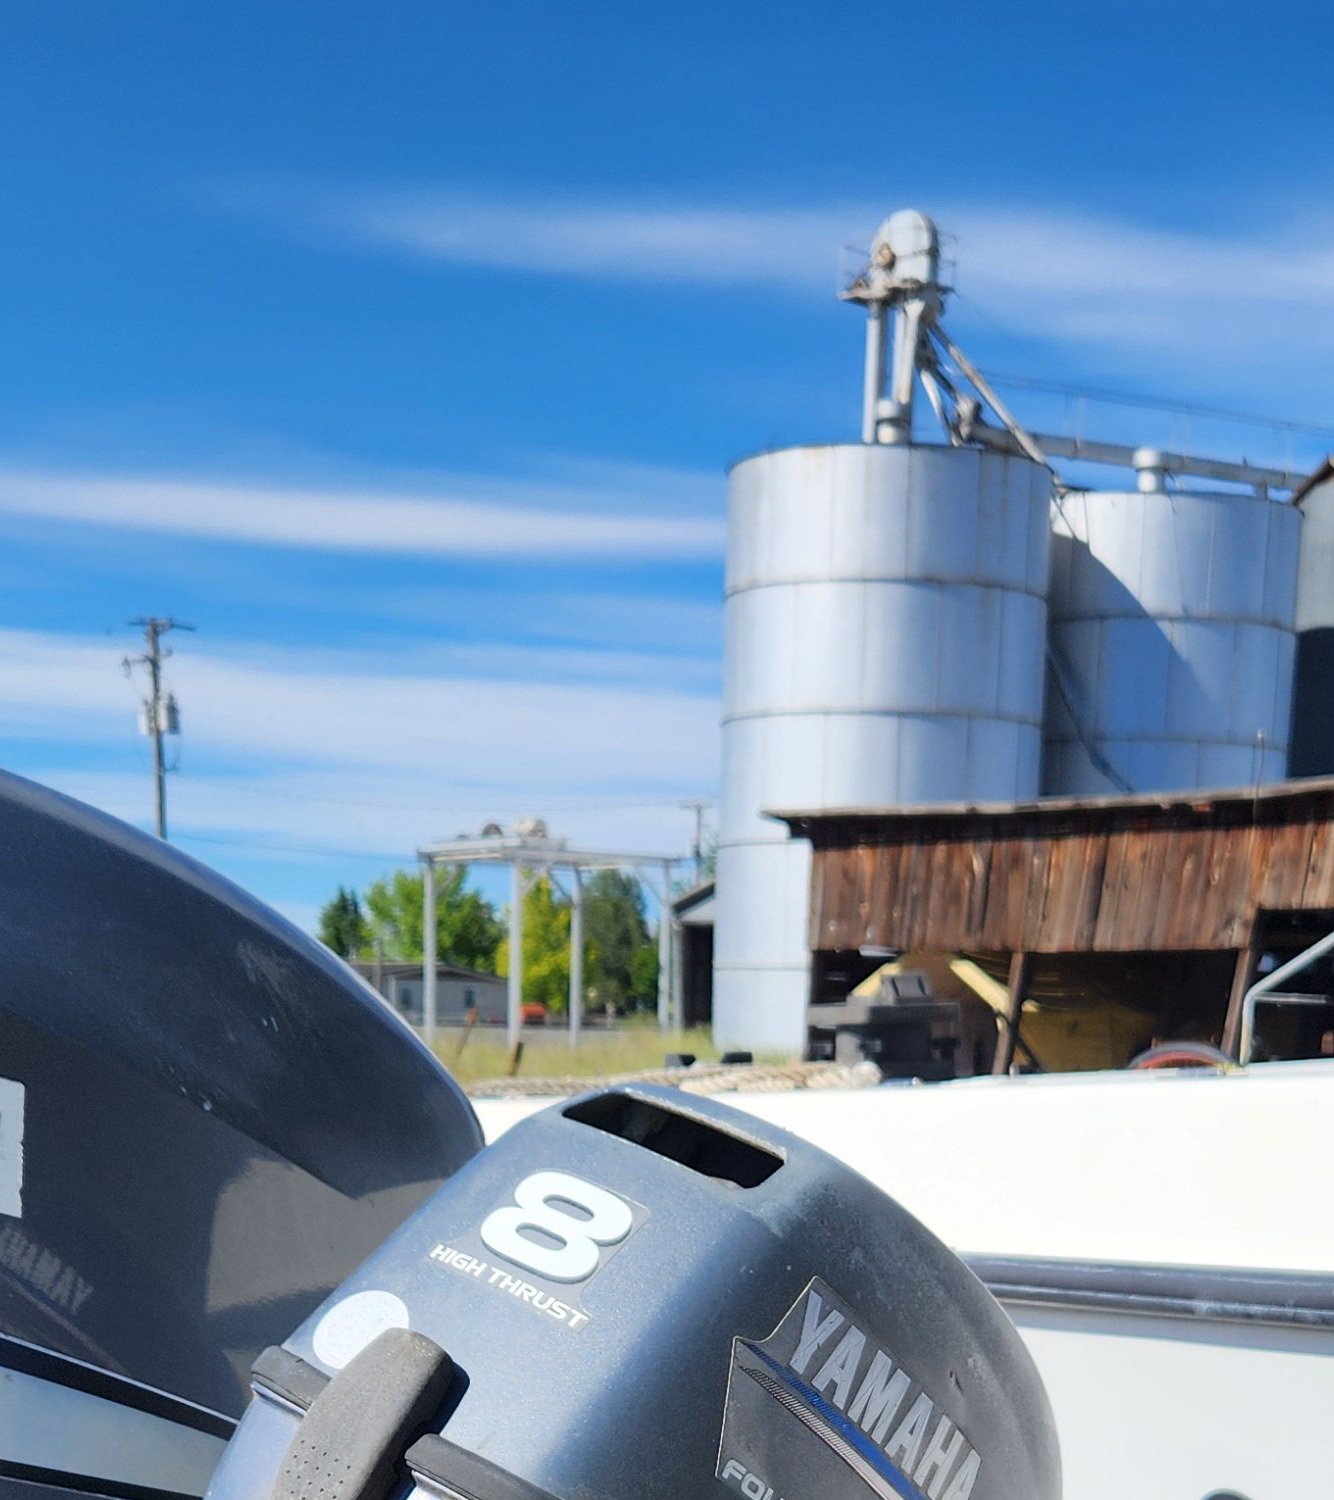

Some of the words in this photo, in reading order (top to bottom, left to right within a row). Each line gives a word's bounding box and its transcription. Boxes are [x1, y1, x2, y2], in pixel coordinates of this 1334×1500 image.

[481, 1171, 633, 1284] 8
[429, 1244, 487, 1277] HIGH
[490, 1267, 589, 1329] THRUST
